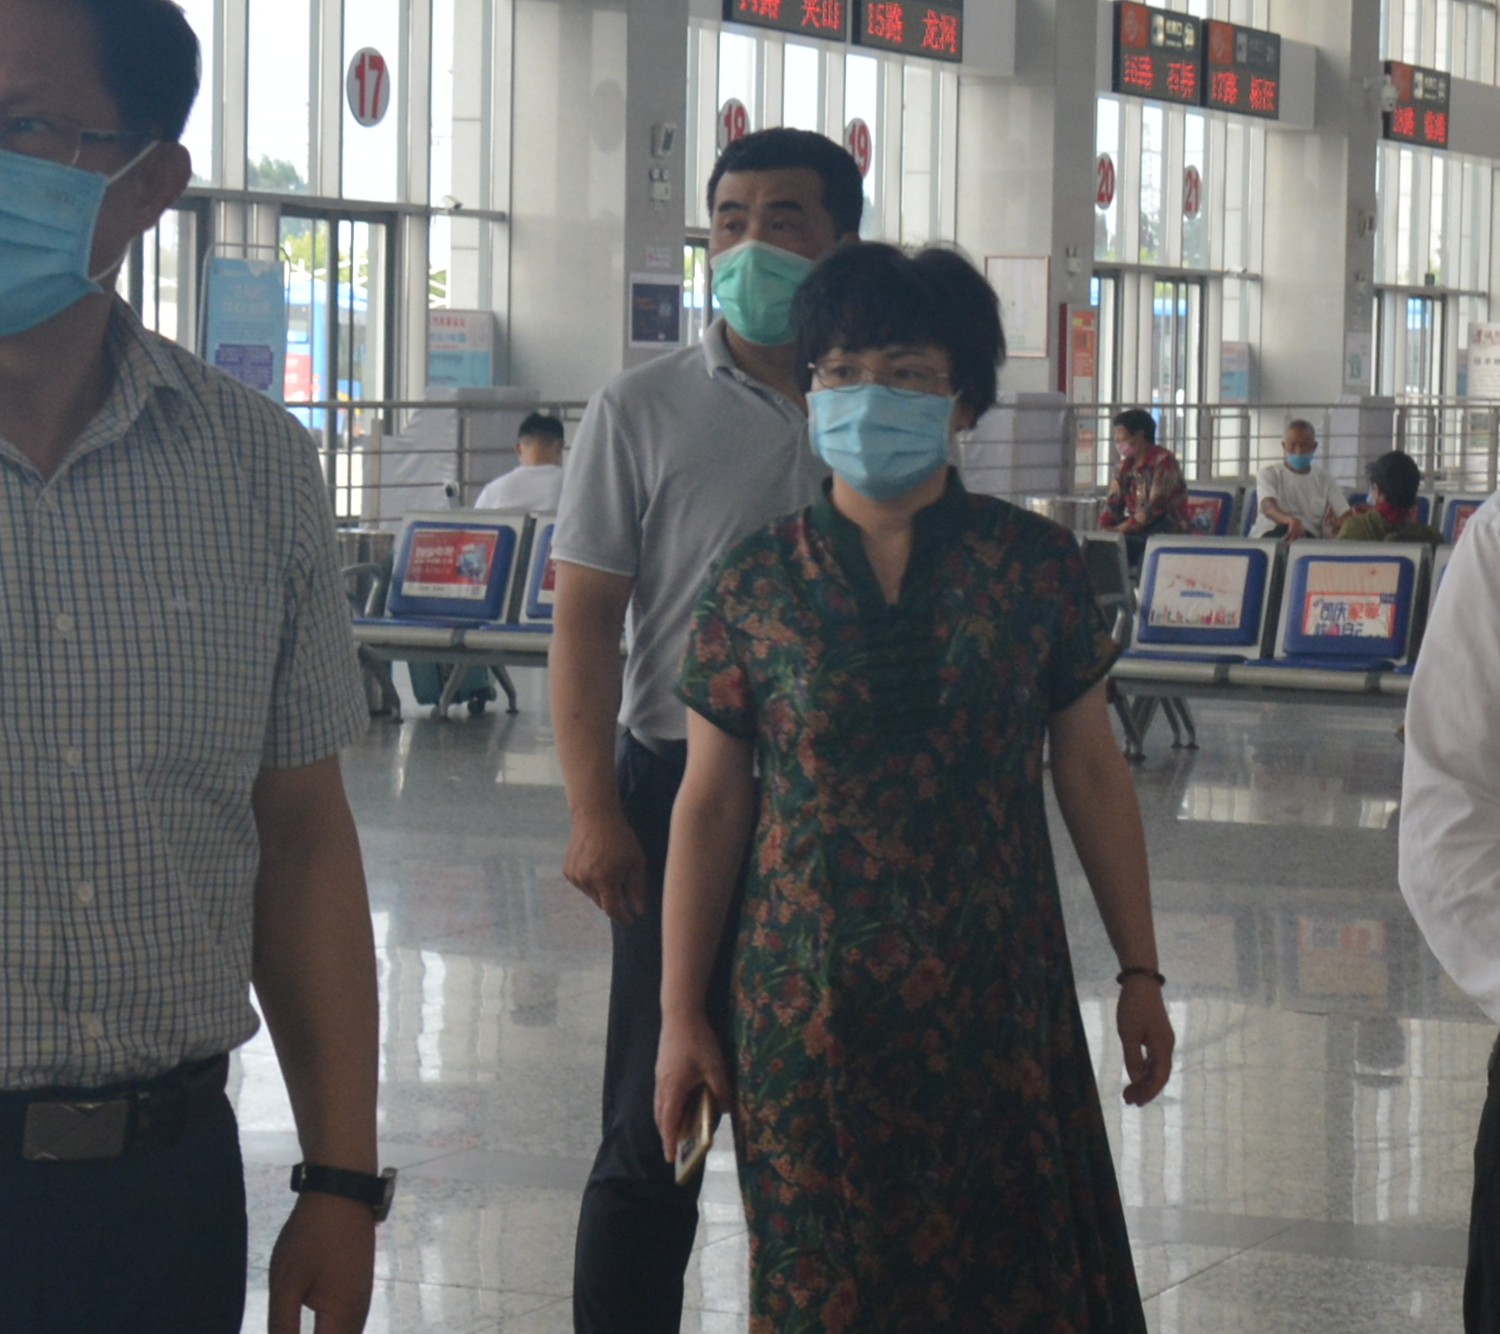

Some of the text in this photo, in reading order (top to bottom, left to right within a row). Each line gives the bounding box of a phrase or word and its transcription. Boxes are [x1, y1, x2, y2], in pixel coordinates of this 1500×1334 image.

[354, 52, 385, 120] 17
[849, 121, 869, 179] 19
[1097, 157, 1115, 205] 20
[1185, 169, 1200, 213] 21
